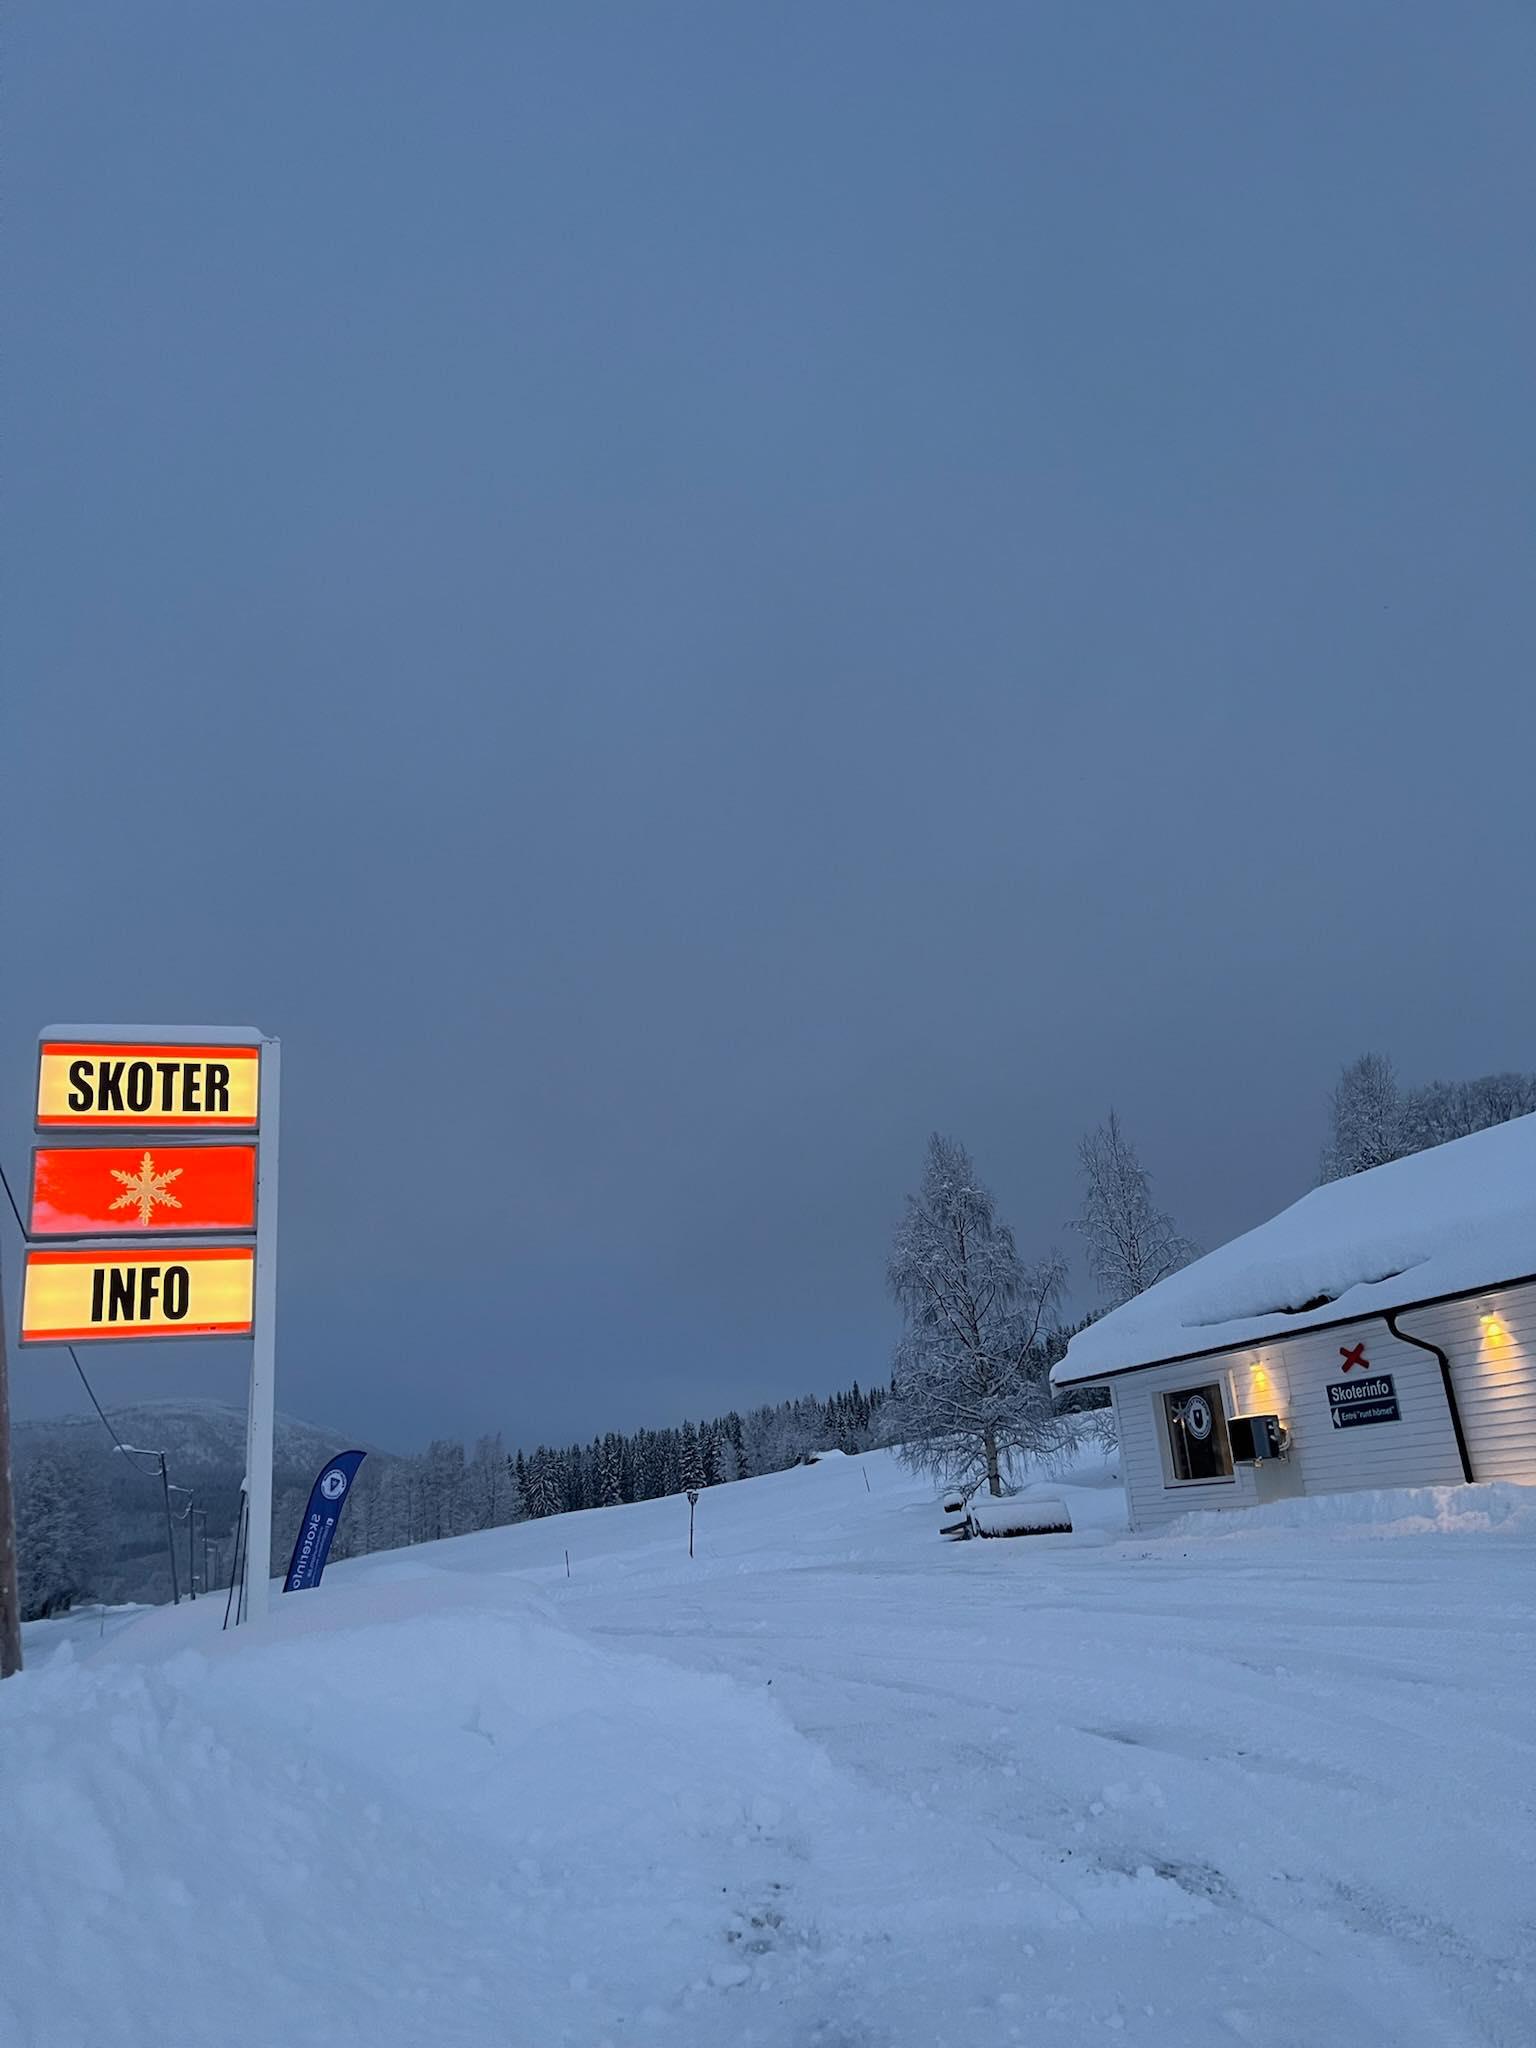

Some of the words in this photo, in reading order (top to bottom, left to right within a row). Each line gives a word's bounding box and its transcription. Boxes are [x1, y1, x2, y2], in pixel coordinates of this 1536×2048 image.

[68, 1060, 229, 1112] SKOTER
[91, 1265, 189, 1321] INFO
[1331, 1380, 1389, 1402] Skoterinfo
